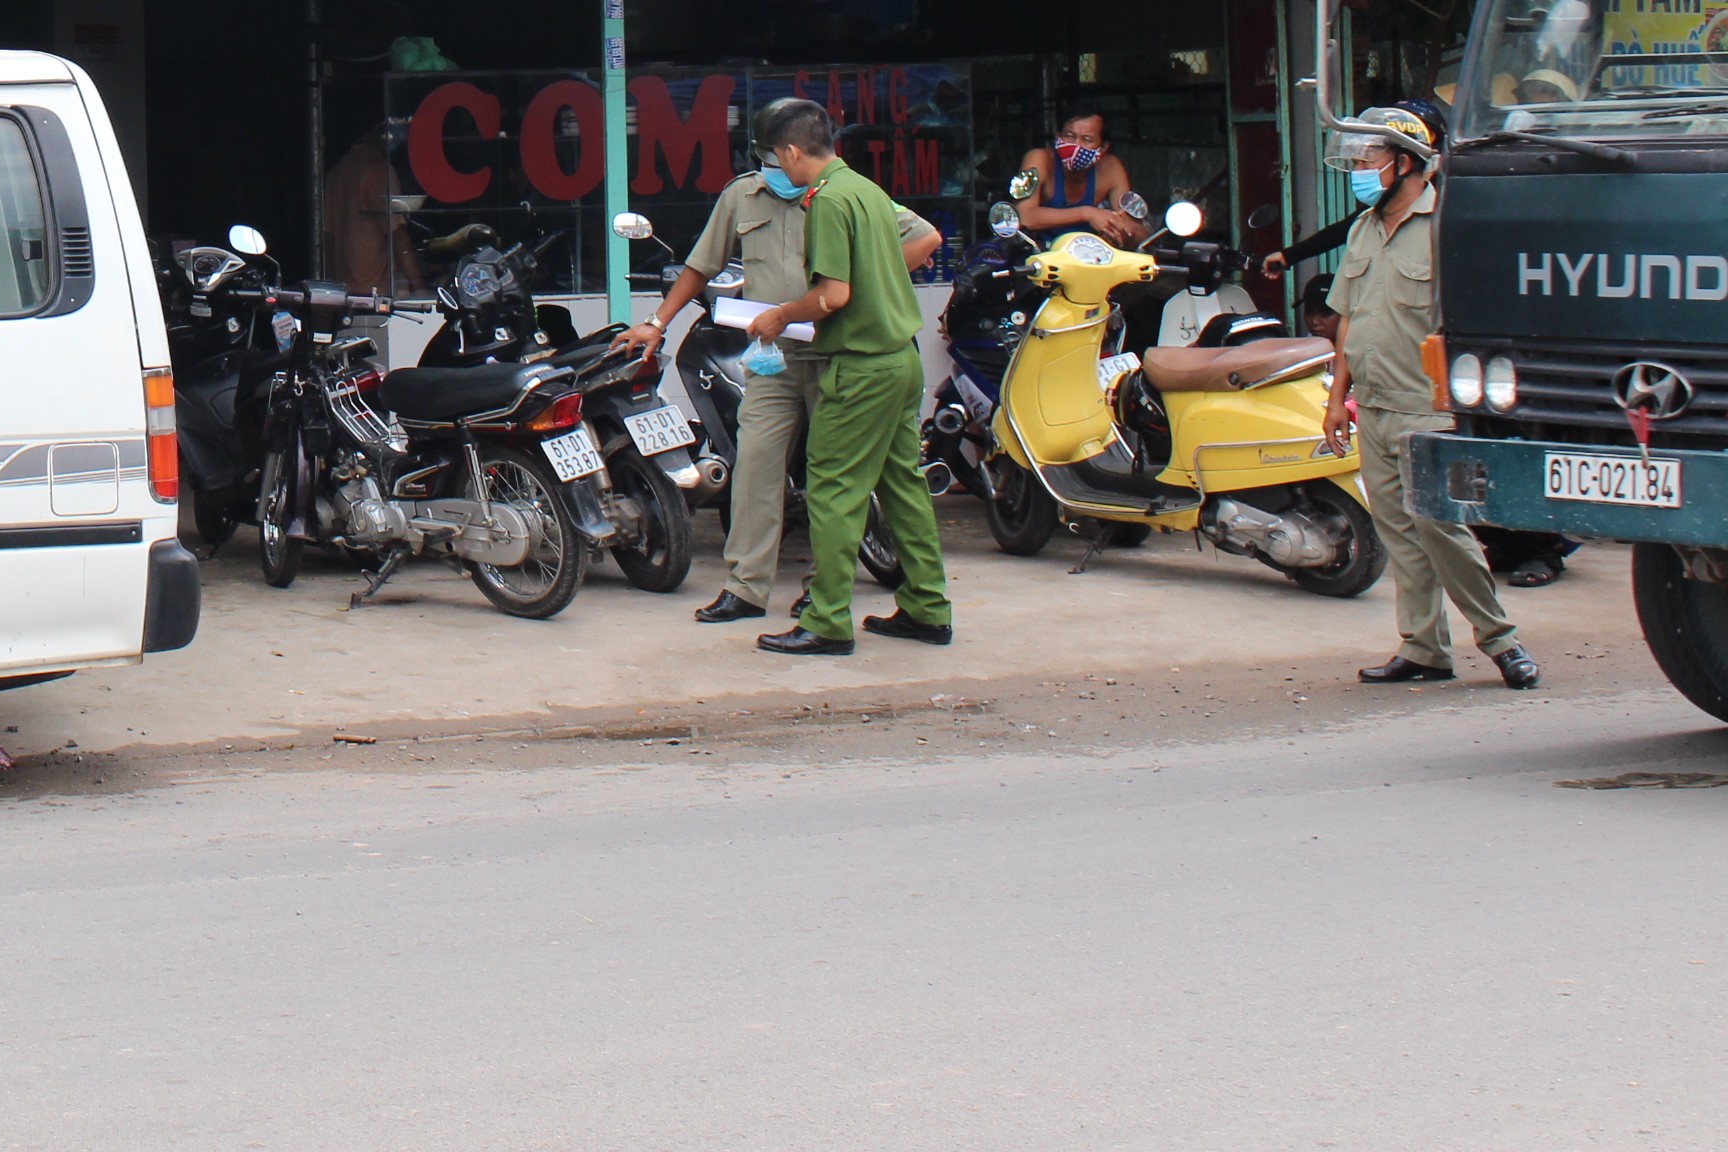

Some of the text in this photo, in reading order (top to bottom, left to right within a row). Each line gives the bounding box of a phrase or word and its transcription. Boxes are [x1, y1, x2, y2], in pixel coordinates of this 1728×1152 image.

[1518, 253, 1728, 301] HYUND
[635, 411, 676, 434] 61-D1
[550, 433, 587, 458] 61-D1
[639, 426, 691, 452] 228.16
[557, 451, 600, 479] 353.87
[1550, 458, 1674, 503] 61C-021.84
